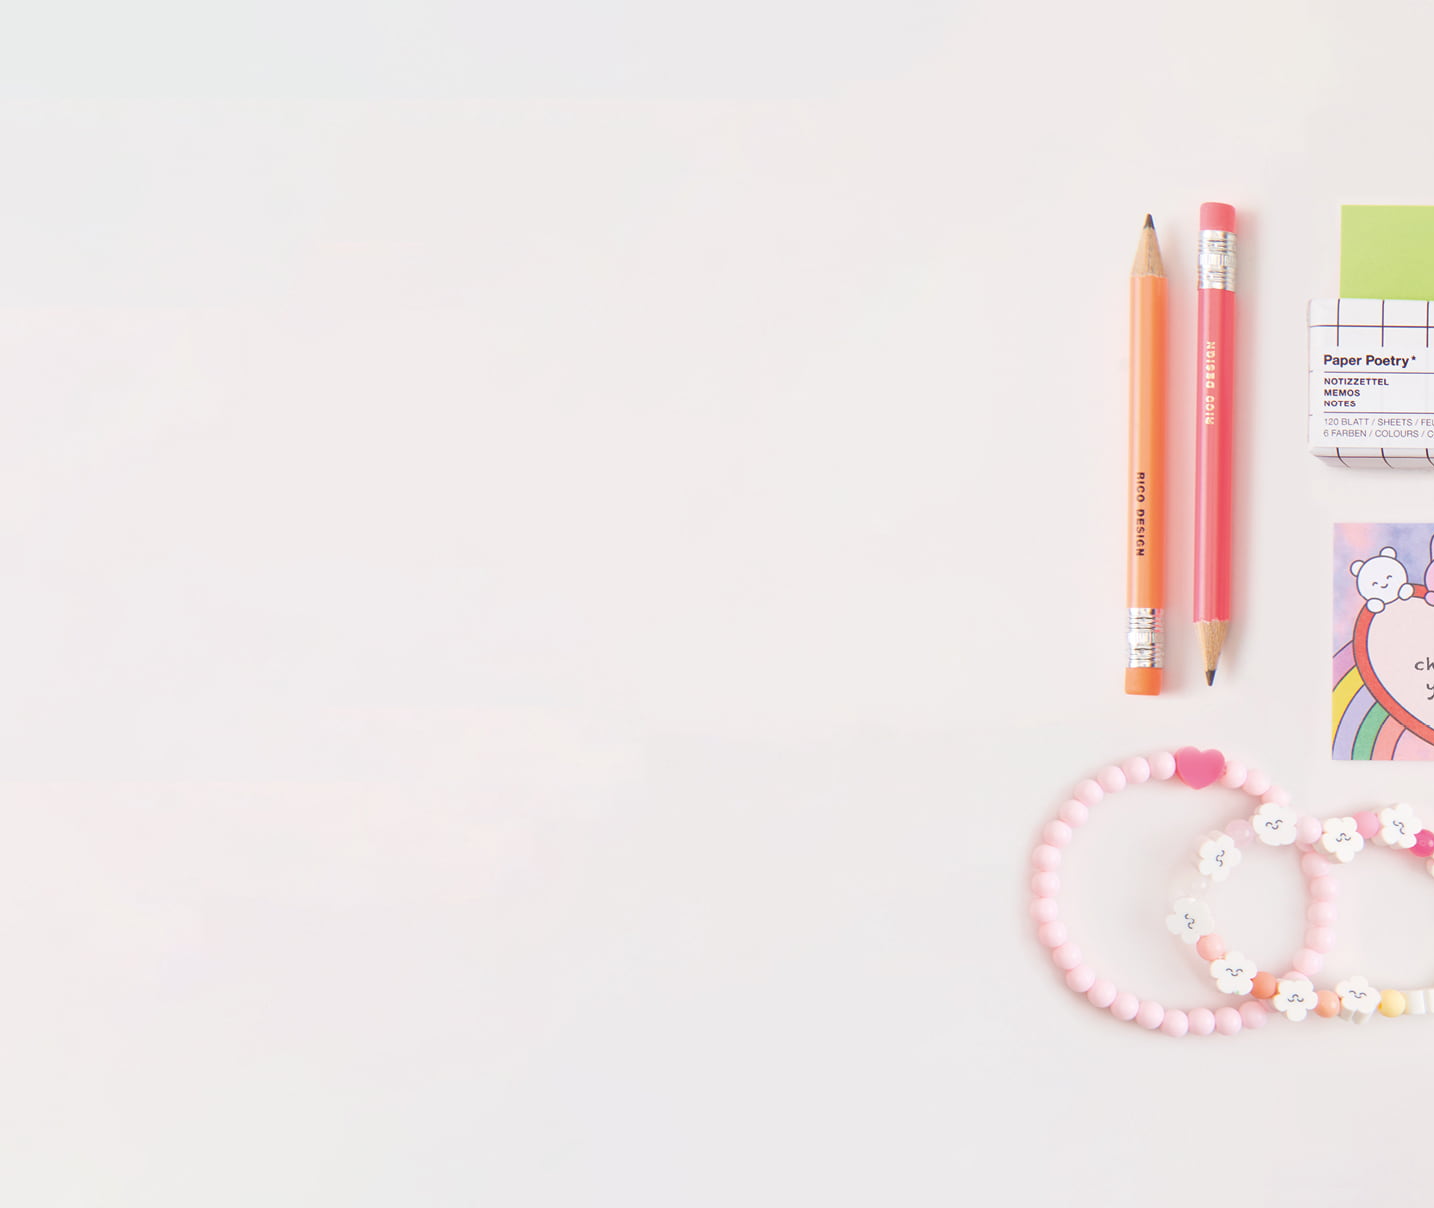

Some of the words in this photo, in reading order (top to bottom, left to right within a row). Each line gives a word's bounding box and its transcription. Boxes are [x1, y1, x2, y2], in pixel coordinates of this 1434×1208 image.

[1205, 341, 1216, 389] DESIGN
[1323, 354, 1362, 368] Paper
[1323, 377, 1390, 386] NOTIZZETTEL
[1323, 388, 1361, 397] MEMOS
[1204, 396, 1215, 425] RICO
[1324, 417, 1339, 426] 120
[1341, 418, 1370, 427] BLATT
[1377, 418, 1413, 427] SHEETS
[1323, 429, 1329, 438] 6
[1331, 429, 1367, 438] FARBEN
[1374, 429, 1419, 438] COLOURS
[1136, 472, 1146, 503] RICO
[1135, 508, 1145, 556] DESIGN
